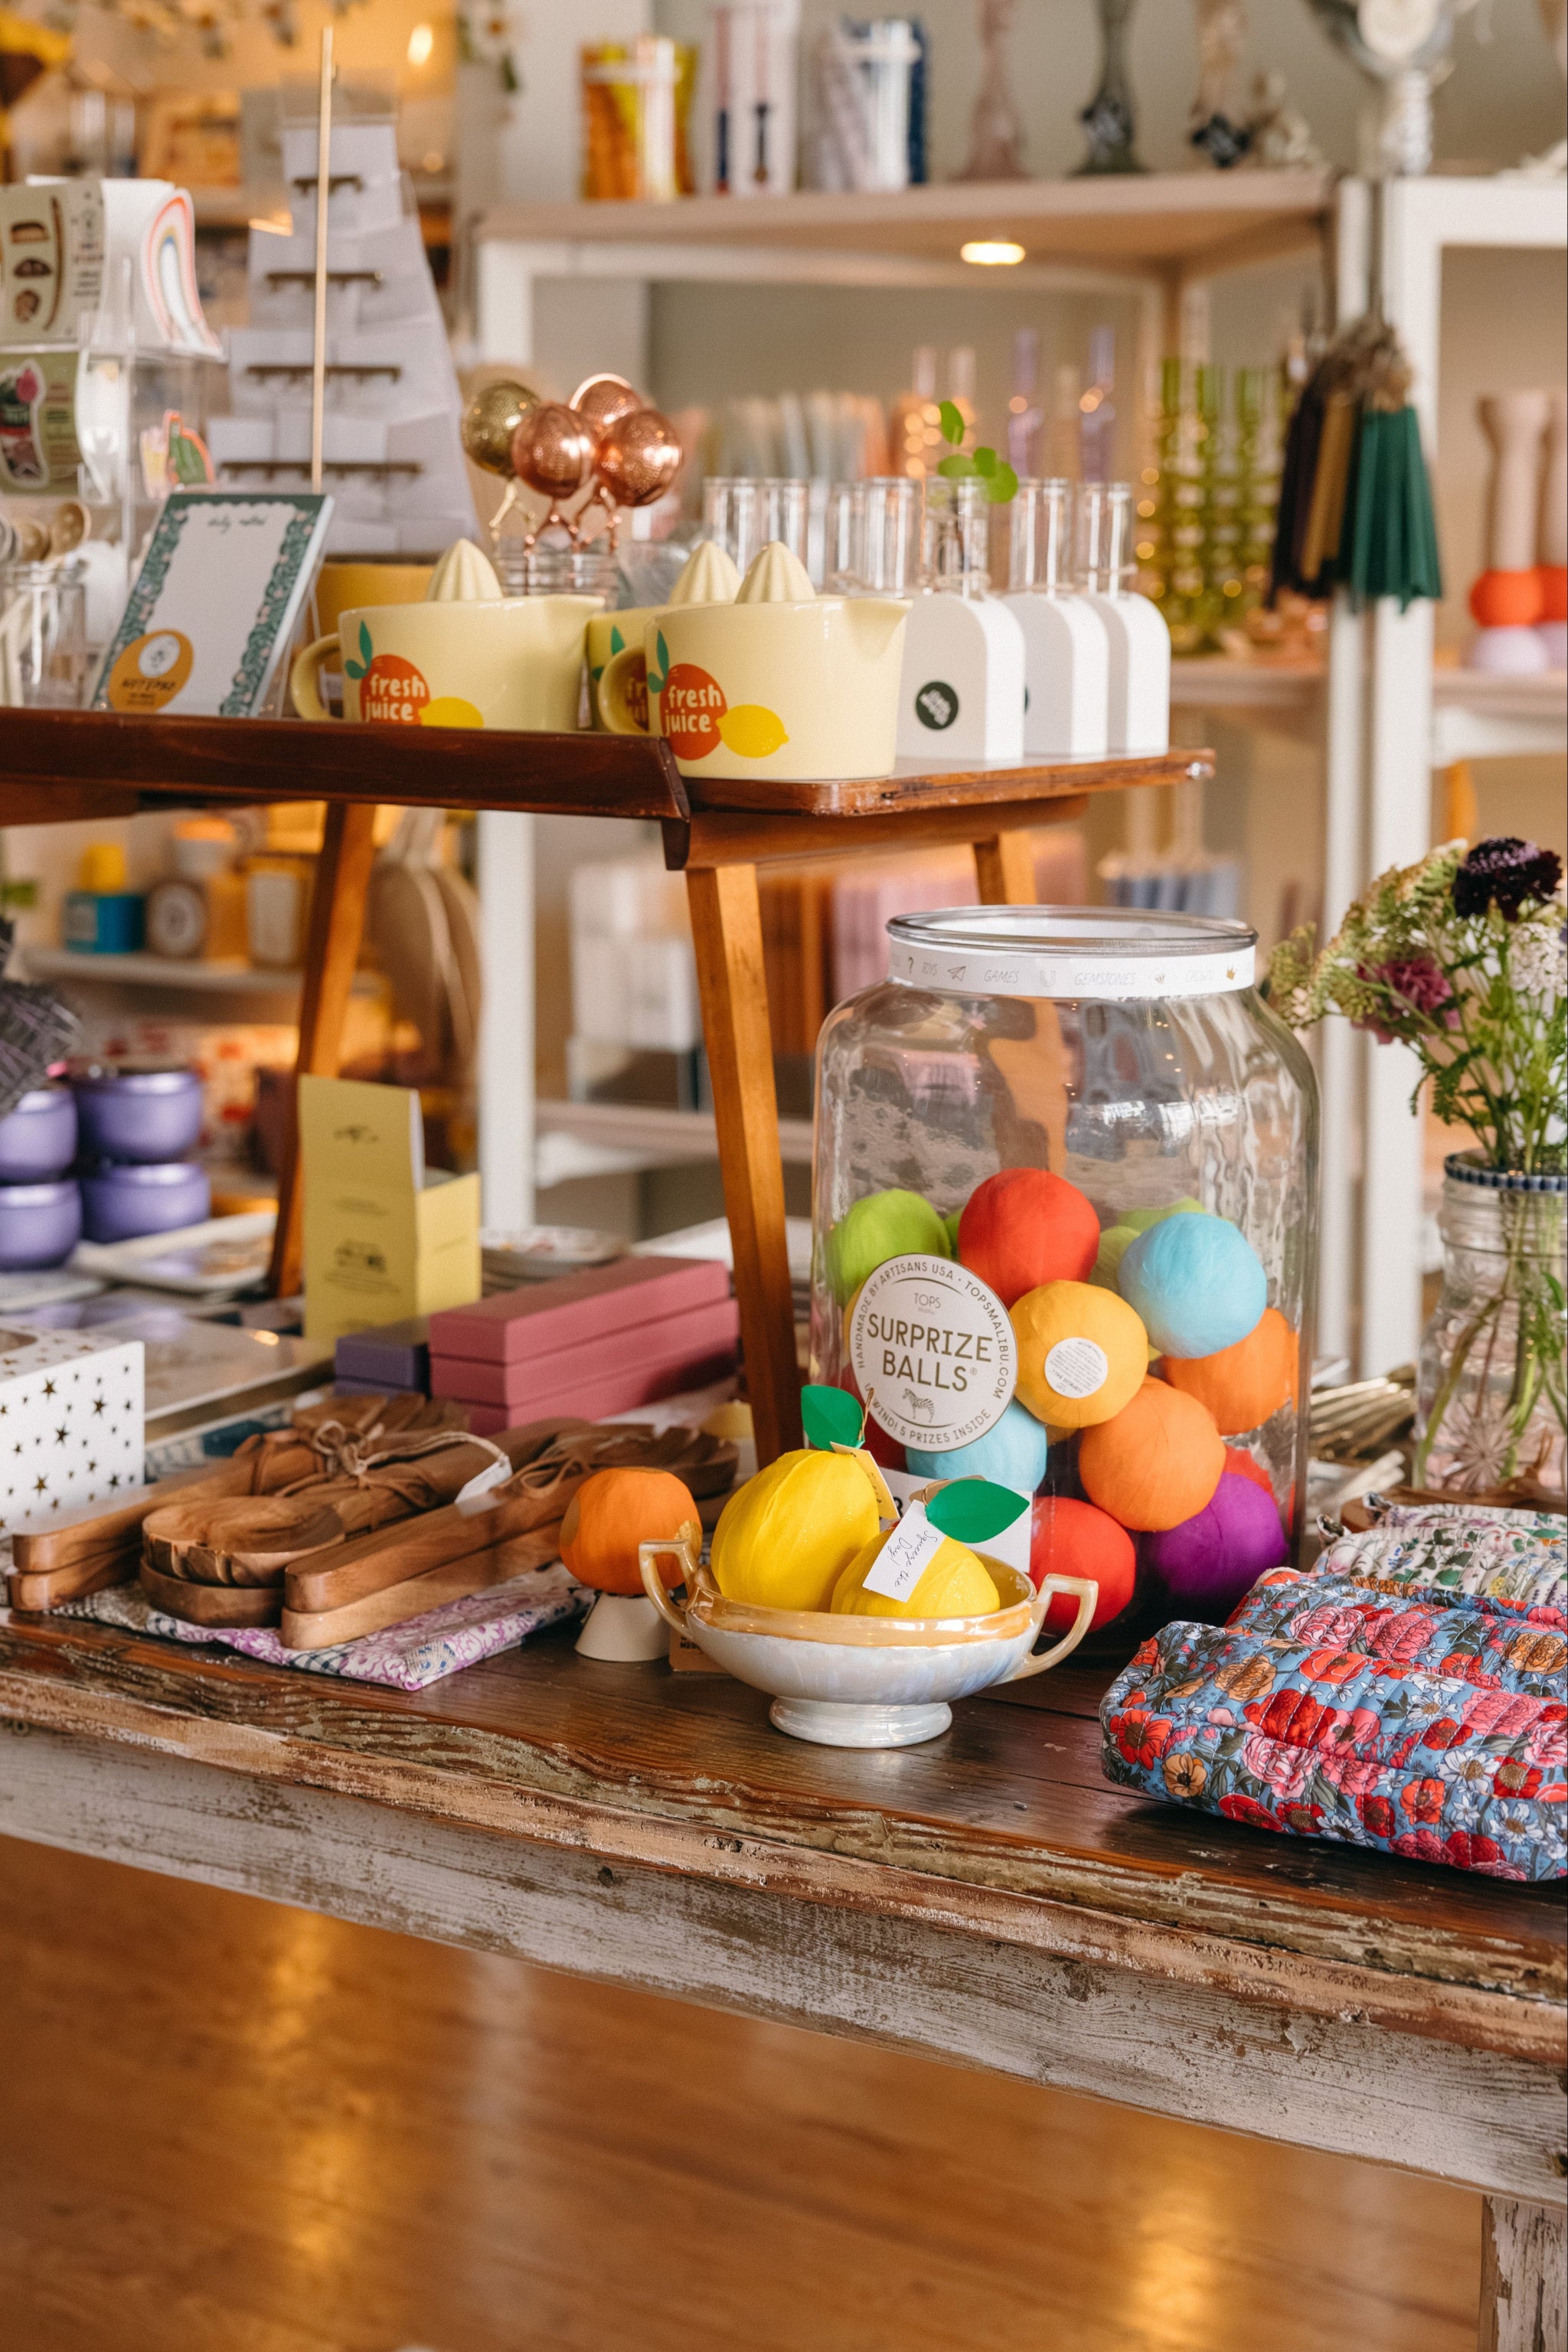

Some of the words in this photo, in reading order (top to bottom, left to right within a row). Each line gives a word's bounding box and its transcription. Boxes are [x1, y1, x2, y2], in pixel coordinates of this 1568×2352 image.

[370, 673, 426, 697] fresh
[668, 684, 721, 708] fresh
[364, 695, 415, 723] juice
[663, 709, 712, 737] juice
[984, 969, 1021, 985] GAMES
[1073, 972, 1137, 987] GEMSTONES
[913, 1292, 942, 1309] TOPS
[855, 1295, 873, 1369] HANDMADE
[869, 1281, 880, 1298] BY
[879, 1261, 928, 1285] ARTISANS
[931, 1263, 954, 1280] USA
[867, 1312, 993, 1363] SURPRIZE
[964, 1280, 1011, 1400] TOPSMALIBU.COM
[899, 1426, 906, 1437] 5
[909, 1429, 951, 1445] PRIZES
[952, 1407, 991, 1441] INSIDE
[905, 1530, 938, 1567] Squeeze
[894, 1570, 910, 1588] the
